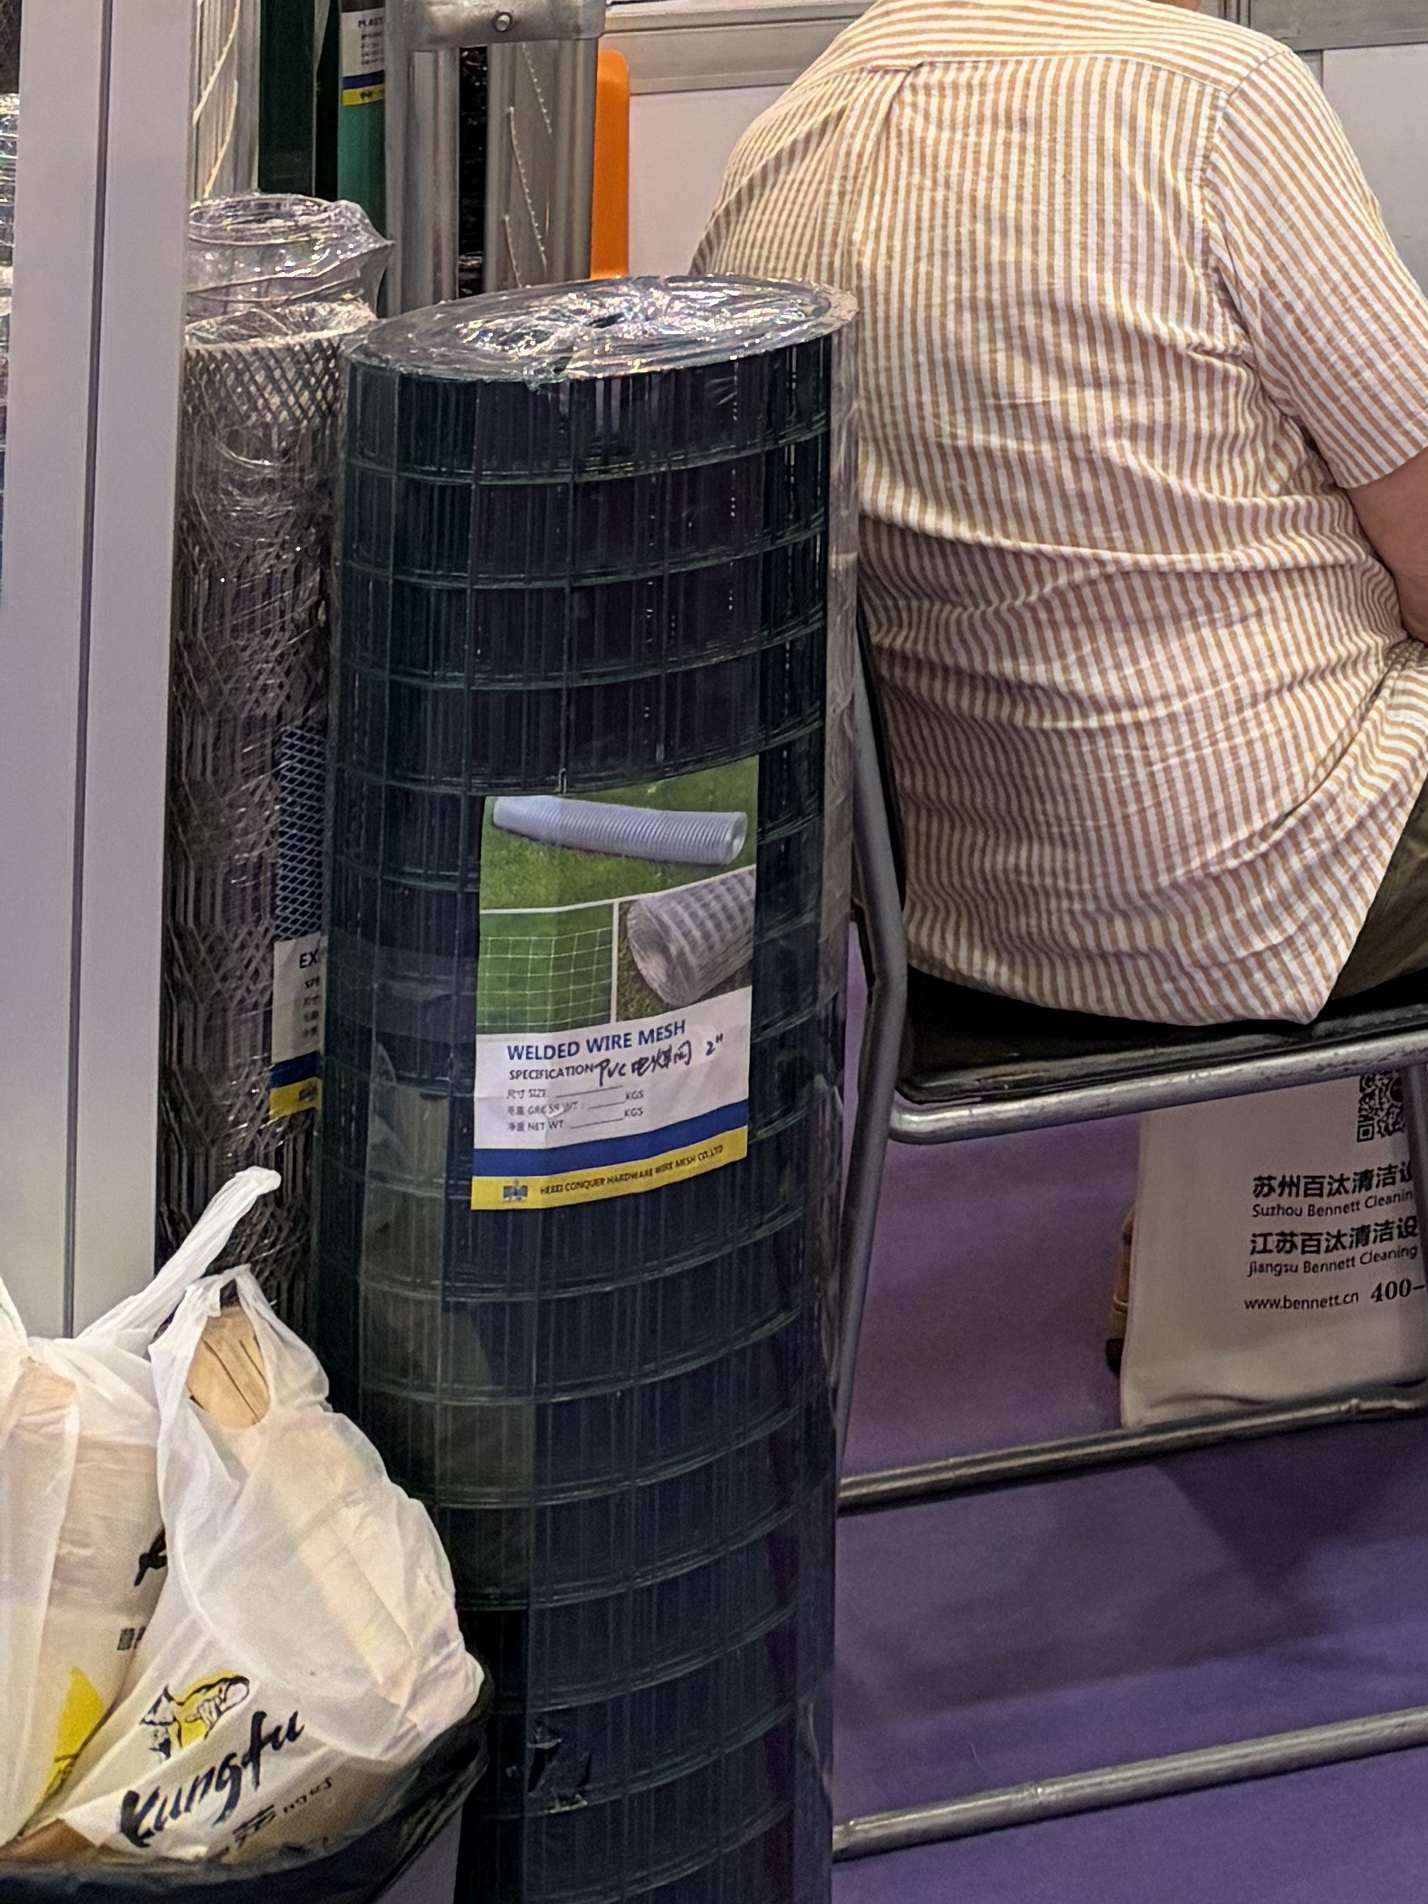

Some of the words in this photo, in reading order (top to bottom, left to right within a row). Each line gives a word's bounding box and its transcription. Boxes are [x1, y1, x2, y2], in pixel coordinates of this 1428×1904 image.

[507, 1040, 581, 1061] WELDED
[586, 1032, 633, 1053] WIRE
[637, 1019, 686, 1044] MESH
[509, 1063, 594, 1081] SPECIFICATION
[565, 1177, 606, 1193] CONQUER
[1252, 1204, 1303, 1218] Suzhou
[1307, 1199, 1361, 1218] Bennett
[1364, 1187, 1415, 1210] Cleanin
[1303, 1258, 1356, 1274] Bennett
[1360, 1245, 1419, 1265] Cleaning
[1244, 1293, 1359, 1311] www.bennett.cn
